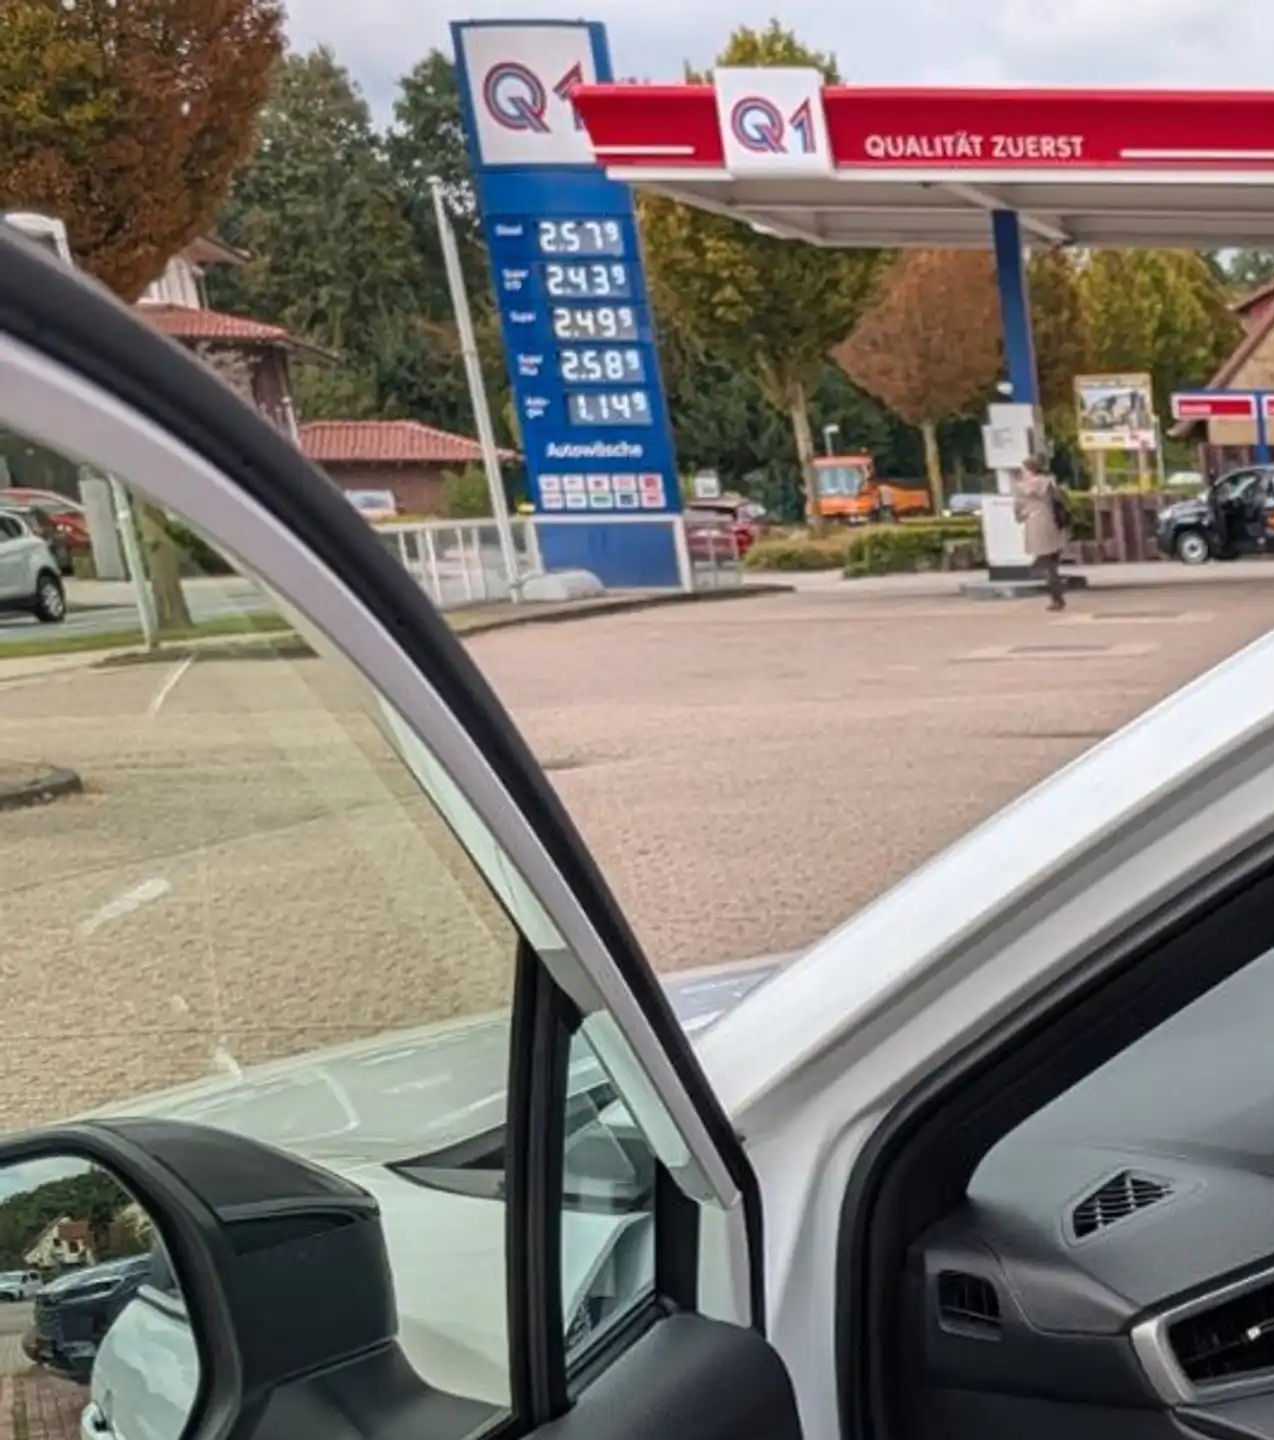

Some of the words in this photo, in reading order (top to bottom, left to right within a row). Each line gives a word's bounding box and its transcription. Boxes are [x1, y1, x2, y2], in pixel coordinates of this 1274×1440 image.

[730, 96, 817, 155] Q1
[863, 131, 984, 158] QUALITÄT
[990, 135, 1084, 158] ZUERST
